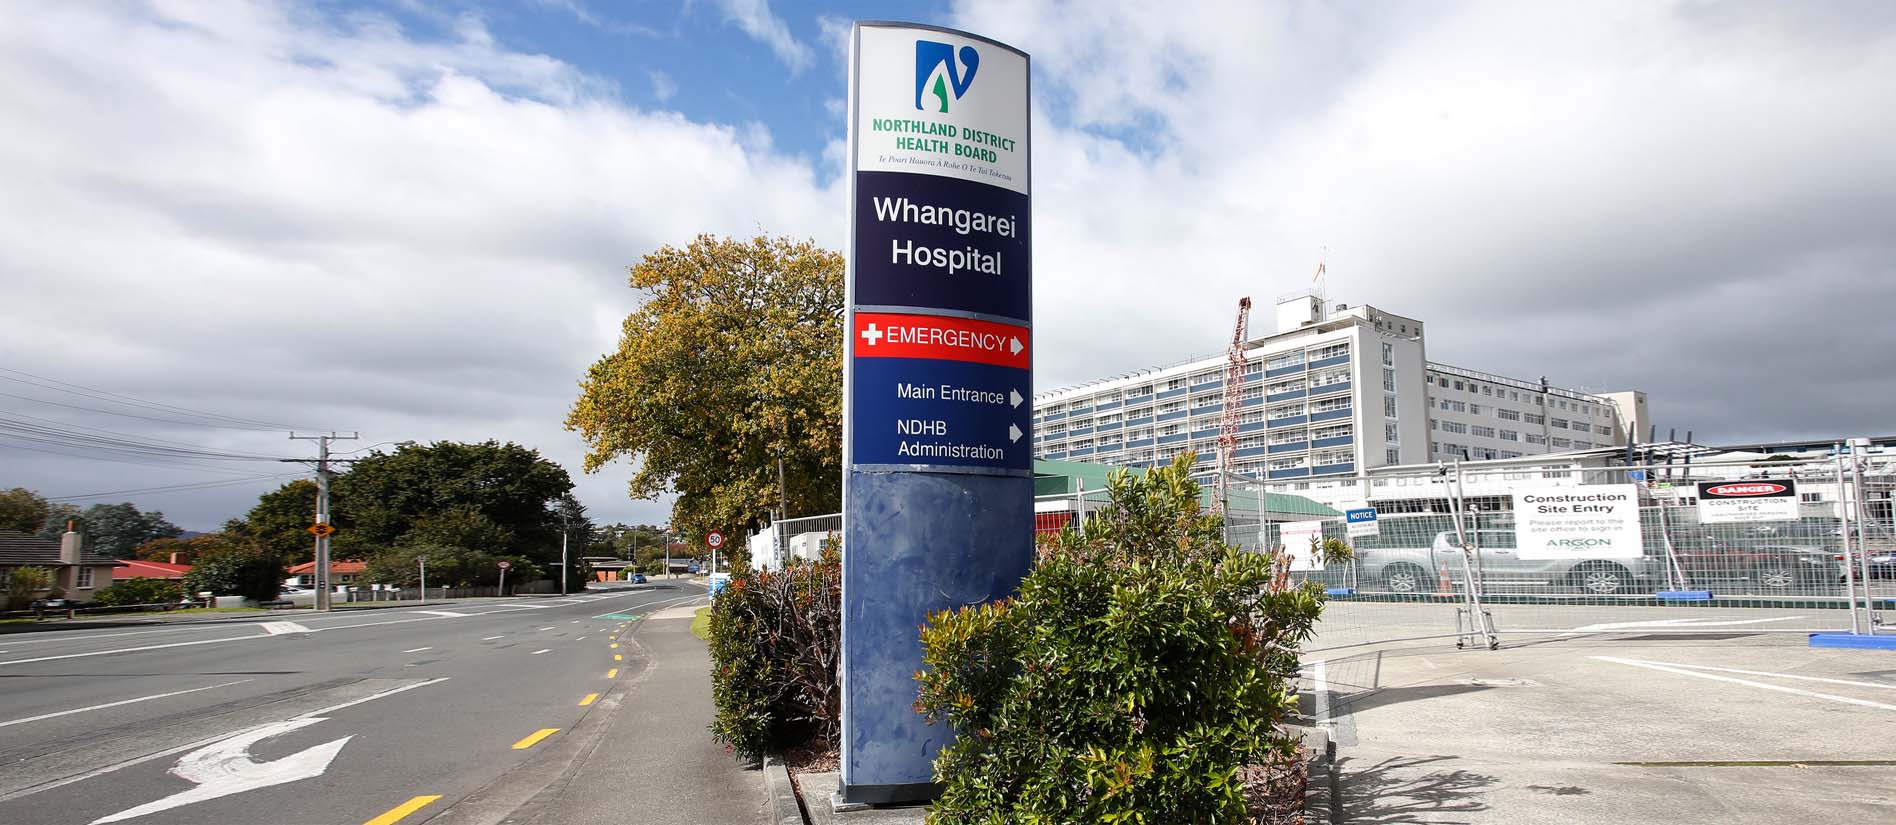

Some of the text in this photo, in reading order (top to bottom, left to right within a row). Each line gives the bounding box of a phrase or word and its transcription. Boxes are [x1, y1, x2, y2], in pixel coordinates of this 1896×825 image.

[872, 118, 1016, 153] NORTHLAND DISTRICT
[896, 137, 997, 164] HEALTH BOARD
[943, 161, 961, 170] Rohe
[969, 164, 977, 173] Te
[873, 196, 1016, 239] Whangarei
[892, 239, 1001, 276] Hospital
[887, 326, 1007, 352] EMERGENCY
[897, 383, 1004, 405] Main Entrance
[897, 419, 947, 436] NDHB
[898, 441, 1004, 460] Administration
[1717, 486, 1774, 494] DANGER
[1524, 494, 1626, 503] Construction
[1708, 498, 1788, 506] CONSTRUCTION
[1350, 511, 1373, 520] NOTICE
[1538, 504, 1614, 513] Site Entry
[710, 535, 720, 544] 50
[1546, 538, 1612, 547] ARGON
